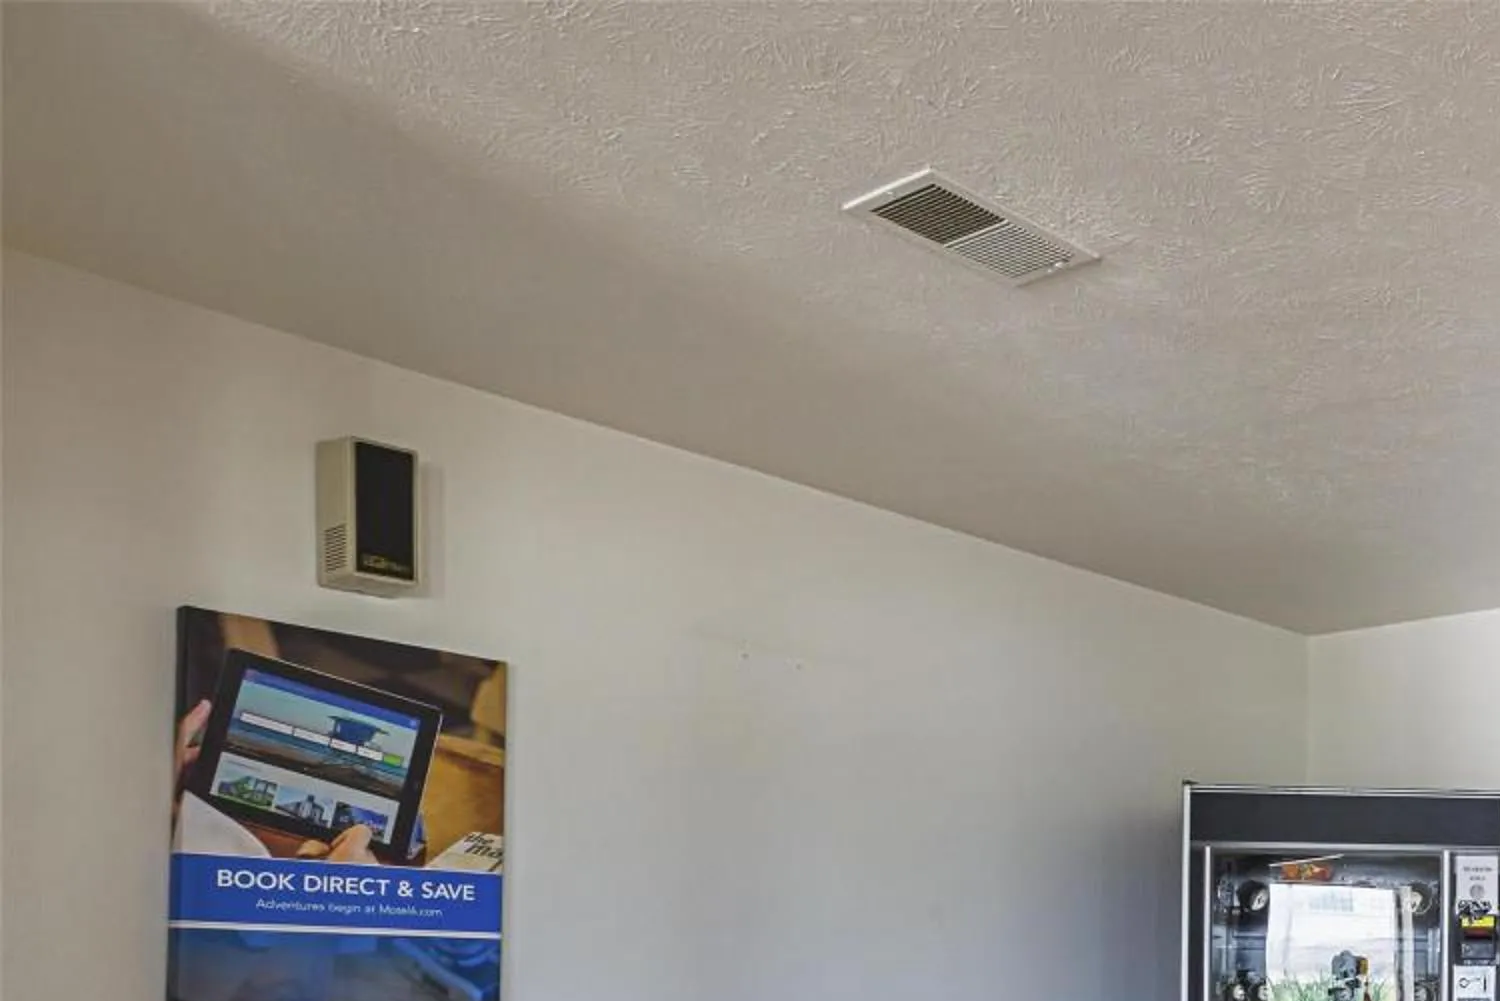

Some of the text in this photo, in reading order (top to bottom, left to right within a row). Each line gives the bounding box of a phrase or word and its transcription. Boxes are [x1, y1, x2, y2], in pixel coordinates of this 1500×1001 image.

[216, 868, 476, 901] BOOK DIRECT & SAVE
[255, 898, 326, 912] Adventures
[327, 902, 361, 915] begin
[365, 904, 375, 913] at
